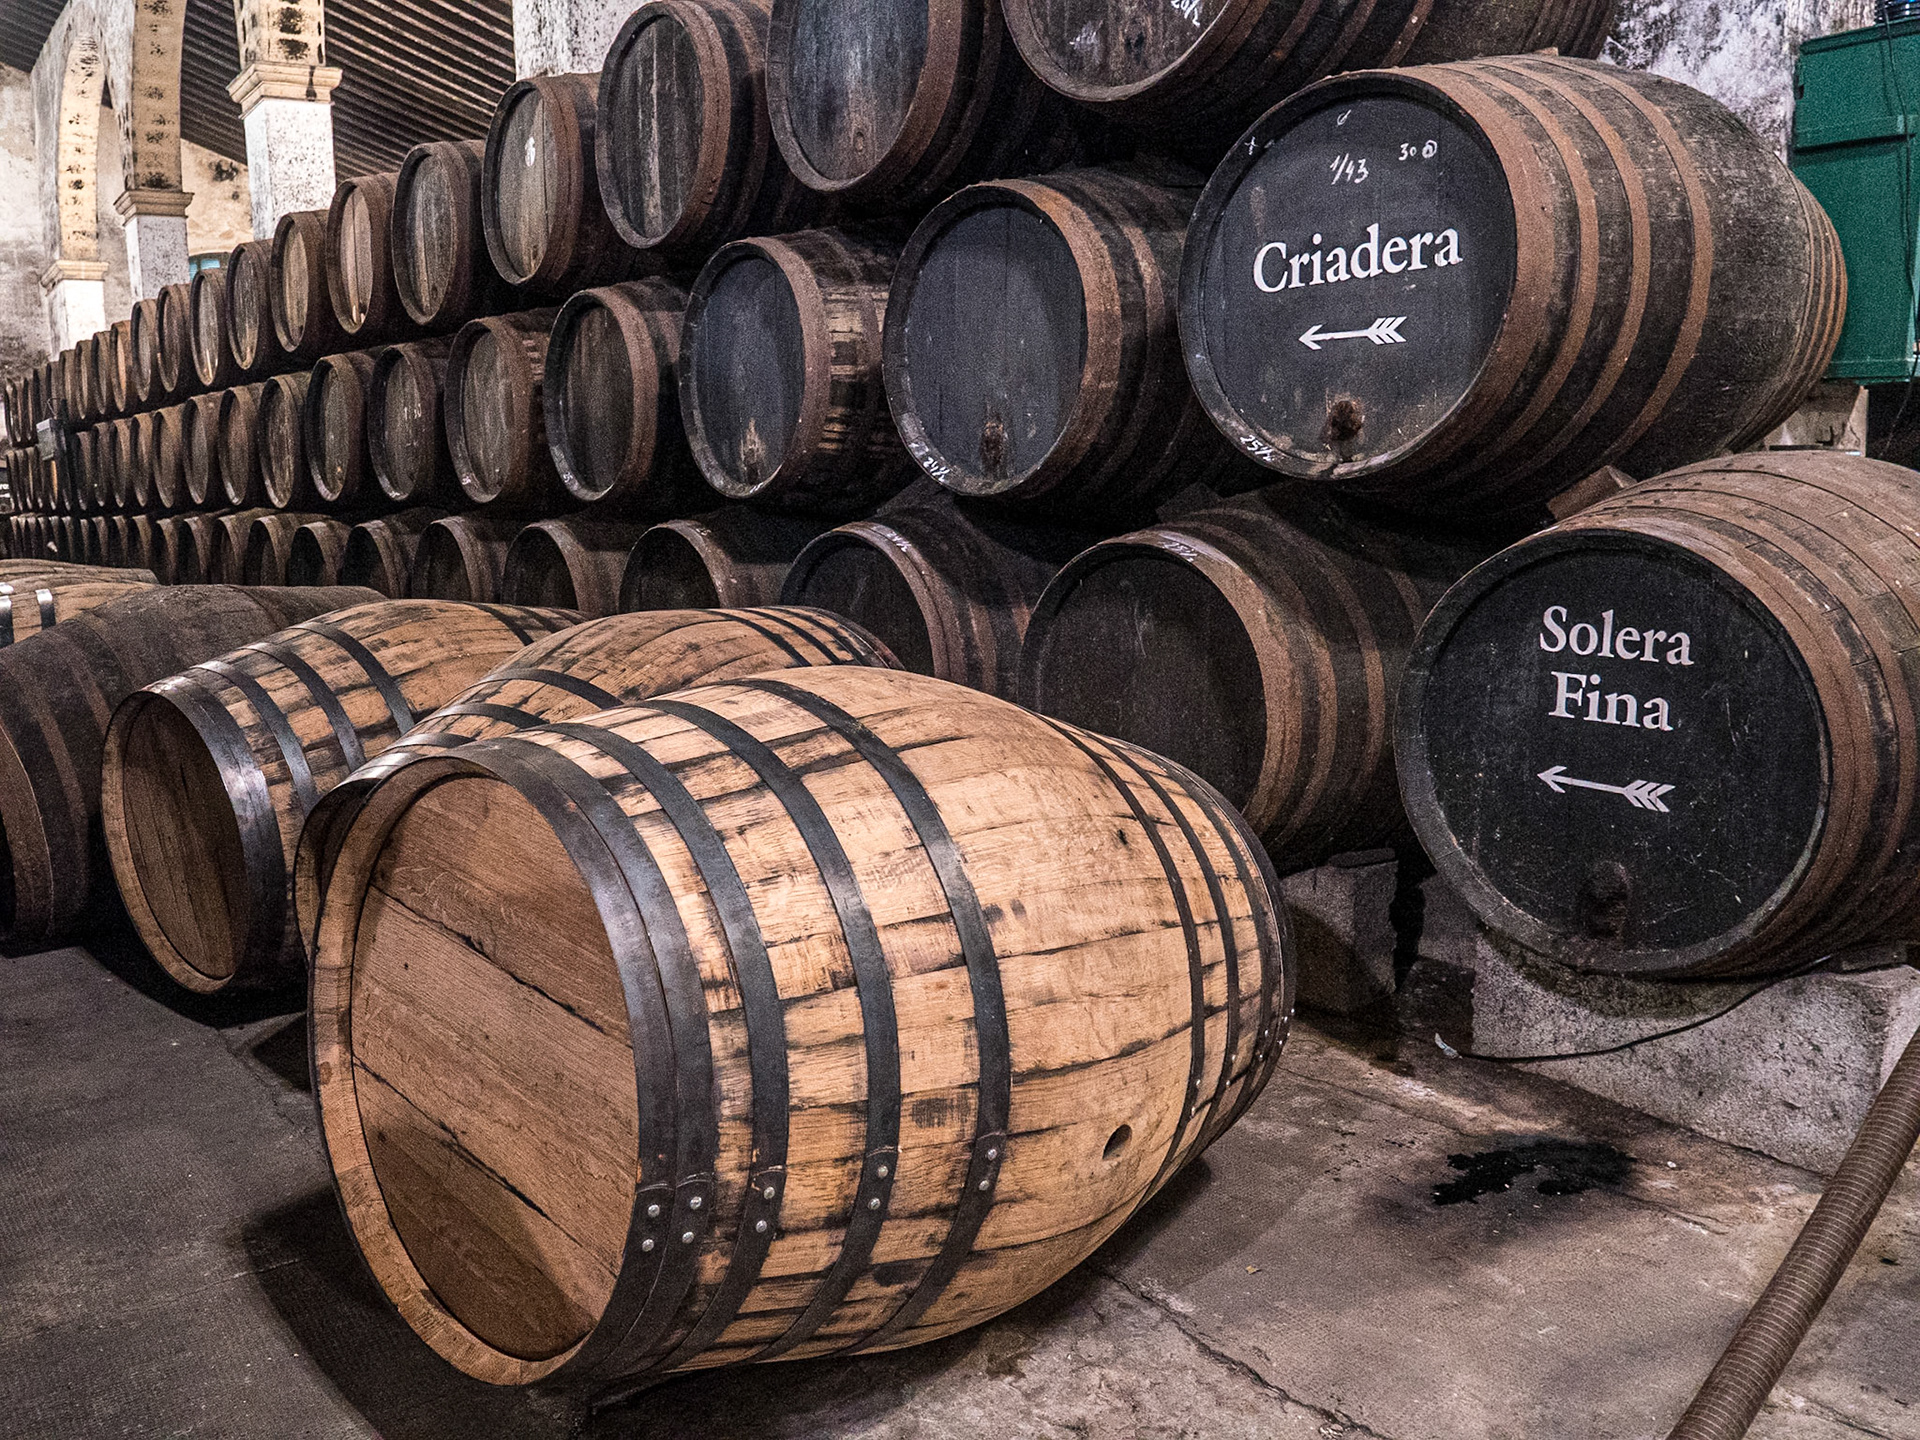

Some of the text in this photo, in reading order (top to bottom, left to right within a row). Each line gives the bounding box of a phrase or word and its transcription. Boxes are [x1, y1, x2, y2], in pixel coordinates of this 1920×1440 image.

[1252, 222, 1464, 293] Criadera
[1539, 604, 1695, 667] Solera
[1548, 670, 1674, 732] Fina
